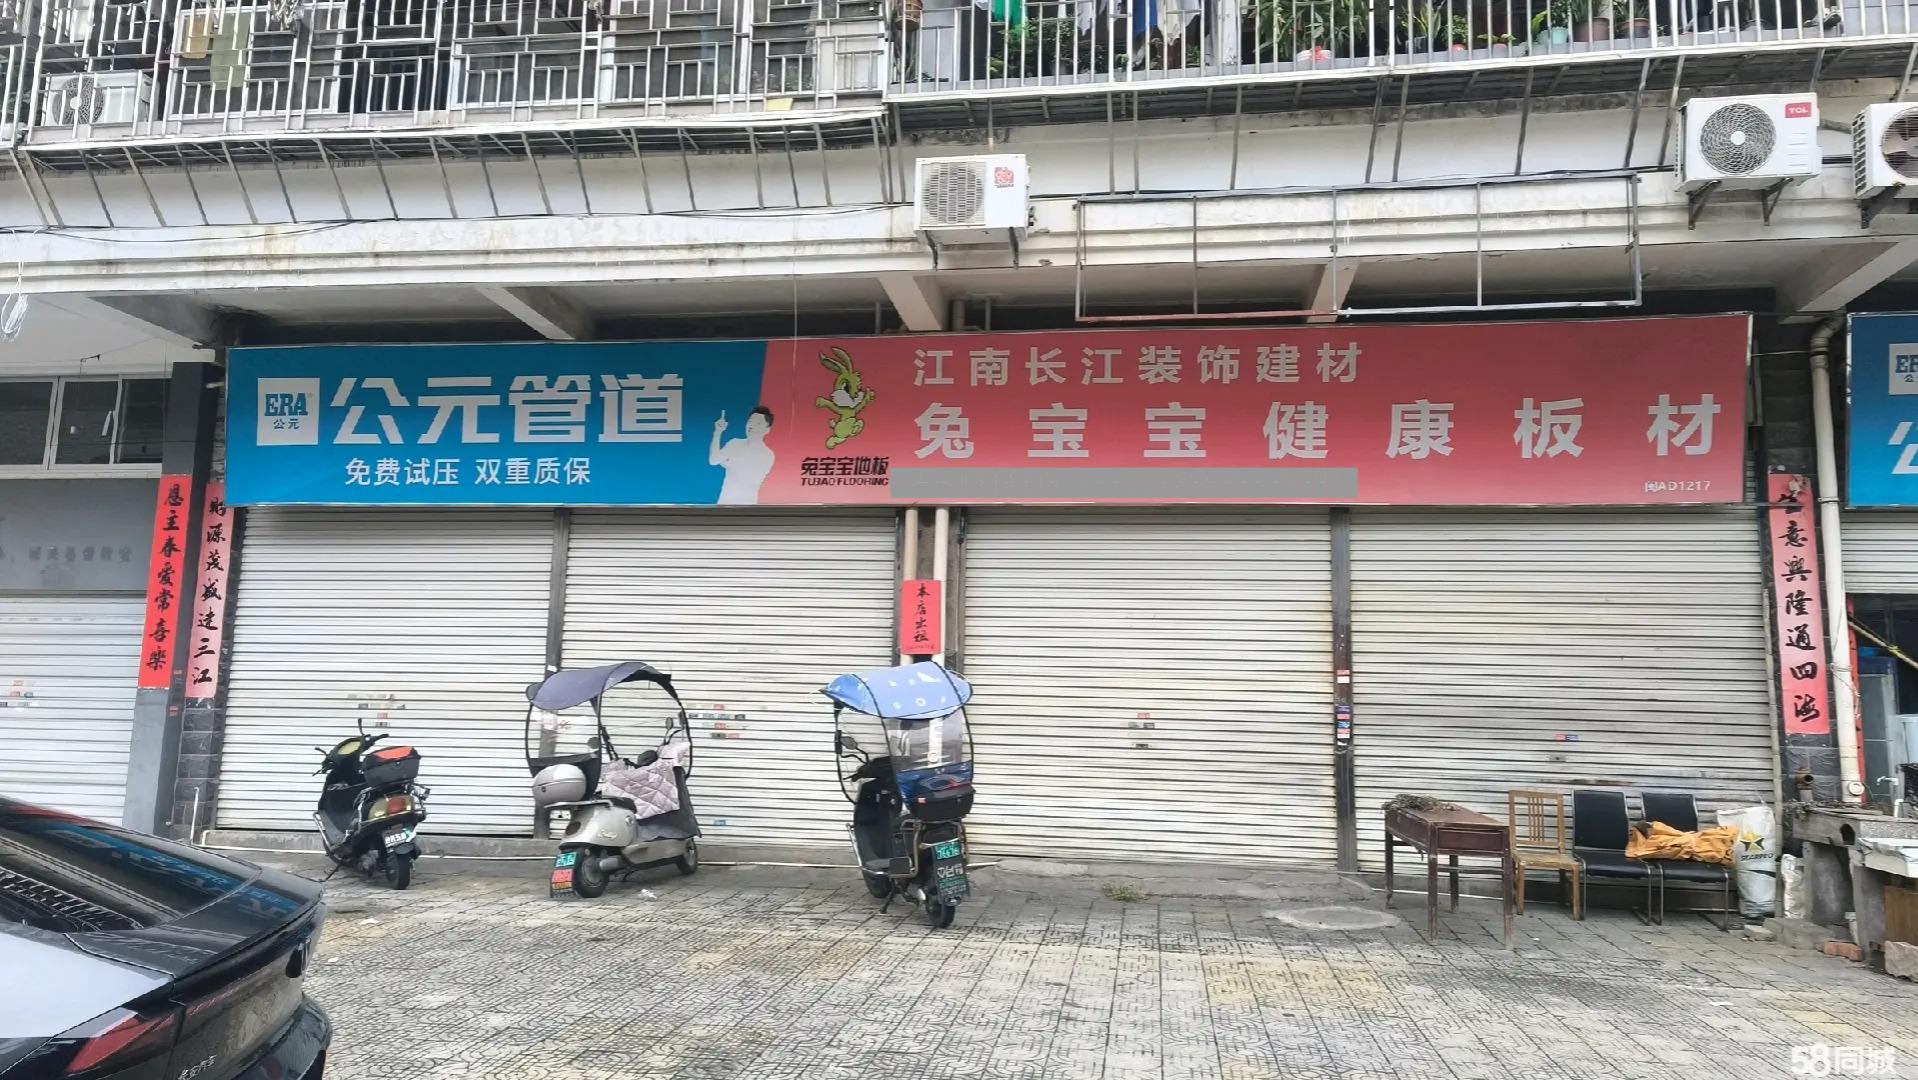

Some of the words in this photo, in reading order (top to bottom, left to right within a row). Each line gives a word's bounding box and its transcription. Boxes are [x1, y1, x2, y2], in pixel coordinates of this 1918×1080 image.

[913, 342, 1362, 386] 江南长江装饰建材
[264, 393, 309, 417] ERA
[330, 374, 684, 444] 公元管道
[273, 418, 300, 430] 公元
[914, 395, 1721, 459] 兔宝宝健康板材
[344, 458, 461, 486] 免费试压
[474, 457, 592, 486] 双重质保
[801, 456, 890, 476] 兔宝宝地板
[801, 477, 836, 486] TUBAO
